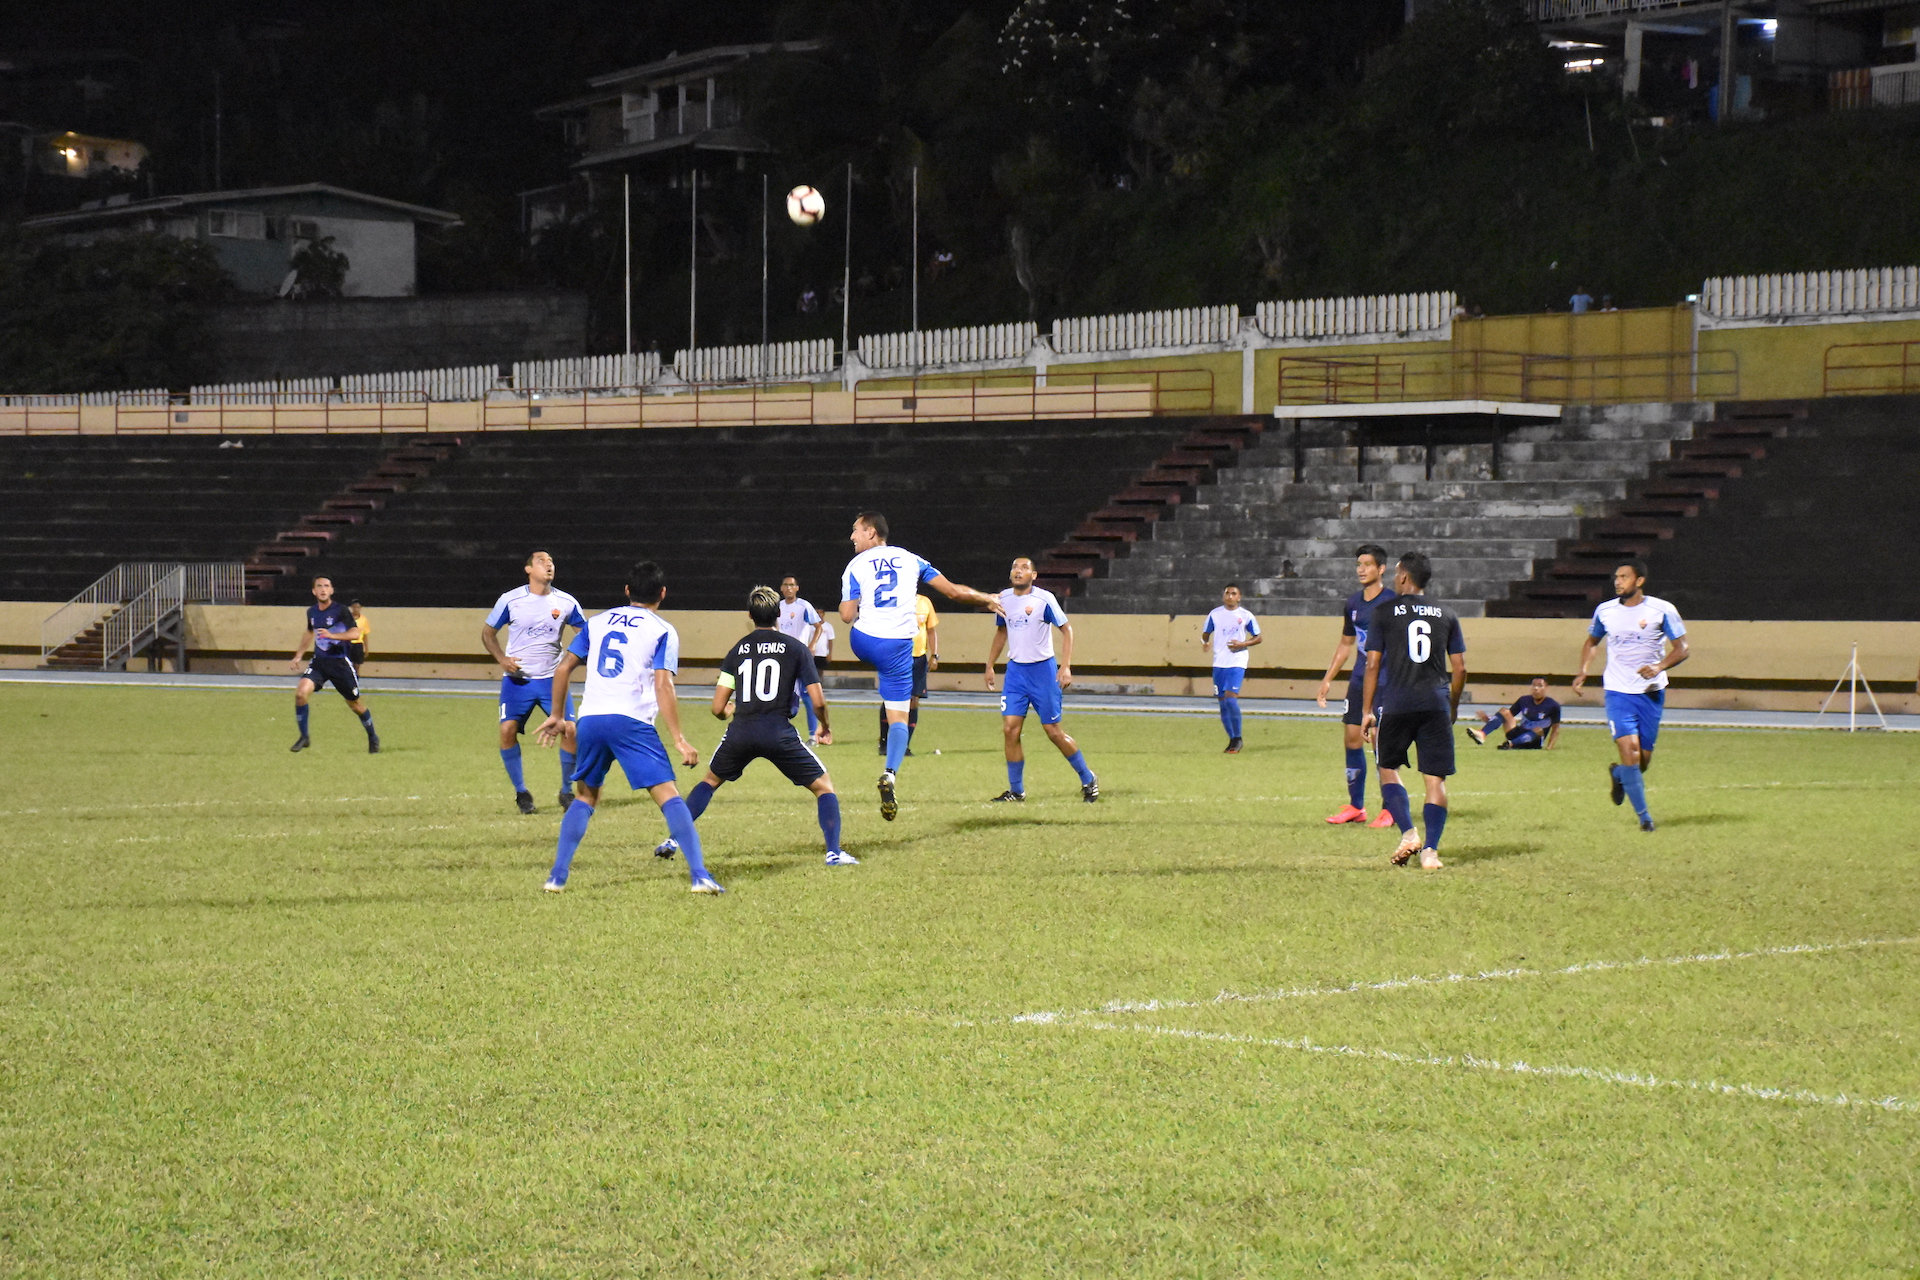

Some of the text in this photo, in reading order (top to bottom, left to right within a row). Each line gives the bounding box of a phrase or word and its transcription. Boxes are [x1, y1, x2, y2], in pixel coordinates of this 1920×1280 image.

[869, 557, 902, 571] TAC
[874, 570, 898, 608] 2
[1394, 604, 1442, 618] AS VENUS
[607, 612, 645, 628] TAC
[738, 642, 786, 655] AS VENUS
[1408, 620, 1431, 663] 6
[597, 630, 628, 678] 6
[738, 658, 780, 702] 10
[1000, 695, 1007, 712] 5
